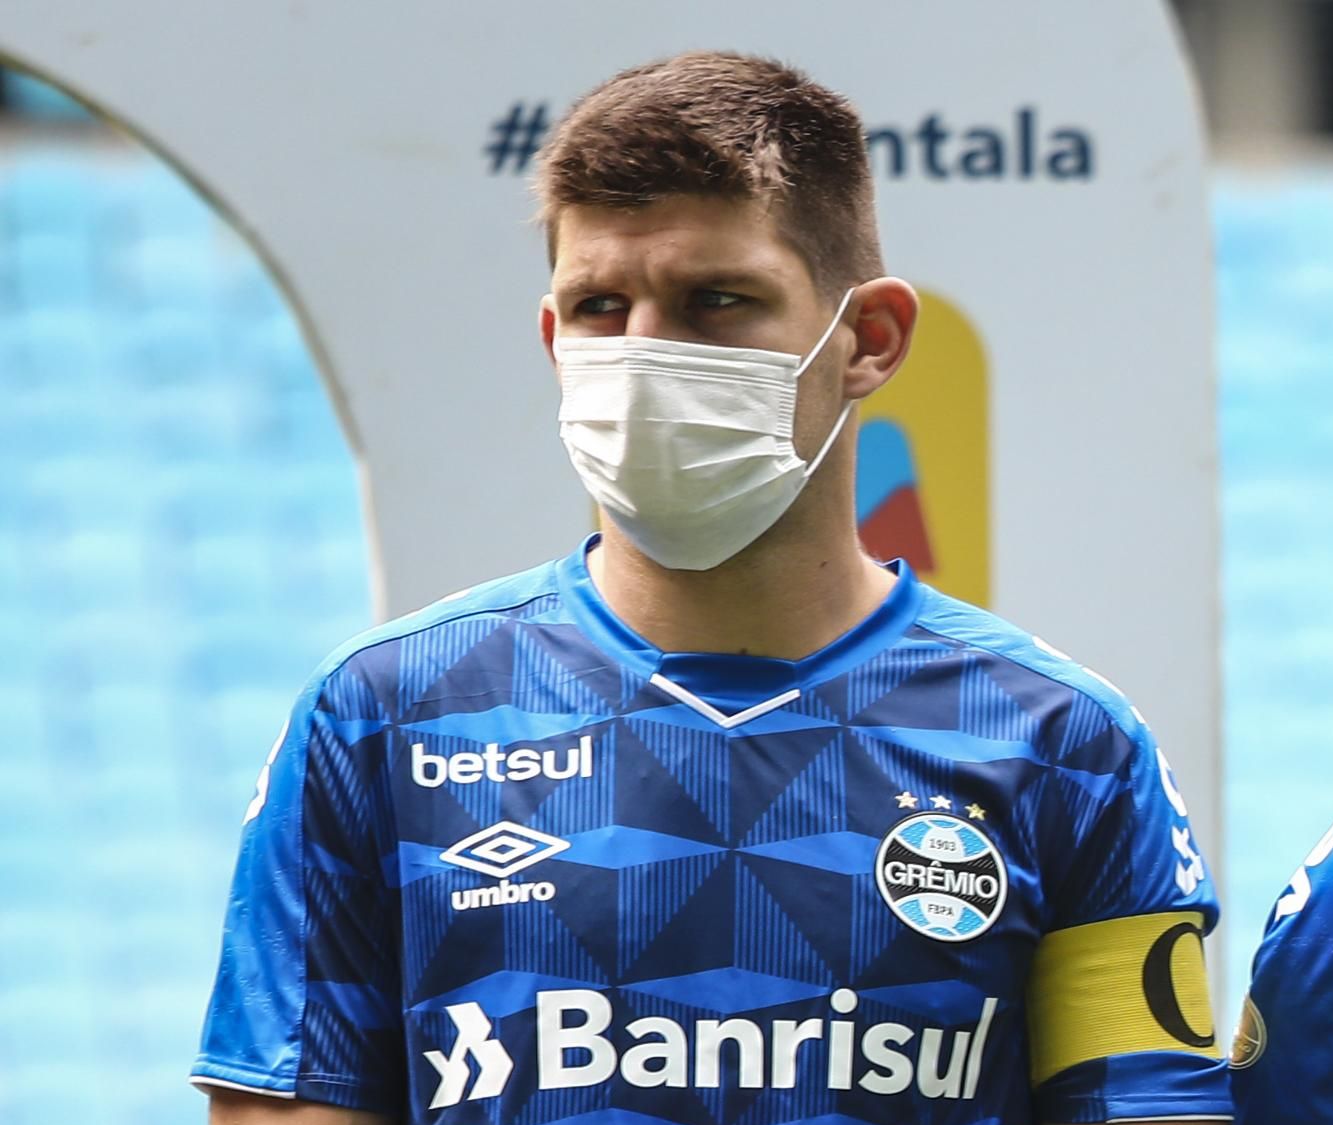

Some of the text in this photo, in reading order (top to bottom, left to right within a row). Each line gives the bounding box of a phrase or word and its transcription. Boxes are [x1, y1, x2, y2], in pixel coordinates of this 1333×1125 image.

[411, 735, 593, 788] betsul
[929, 837, 957, 852] 1903
[450, 877, 557, 912] umbro
[884, 860, 999, 899] GRÊMIO
[536, 988, 998, 1100] Banrisul
